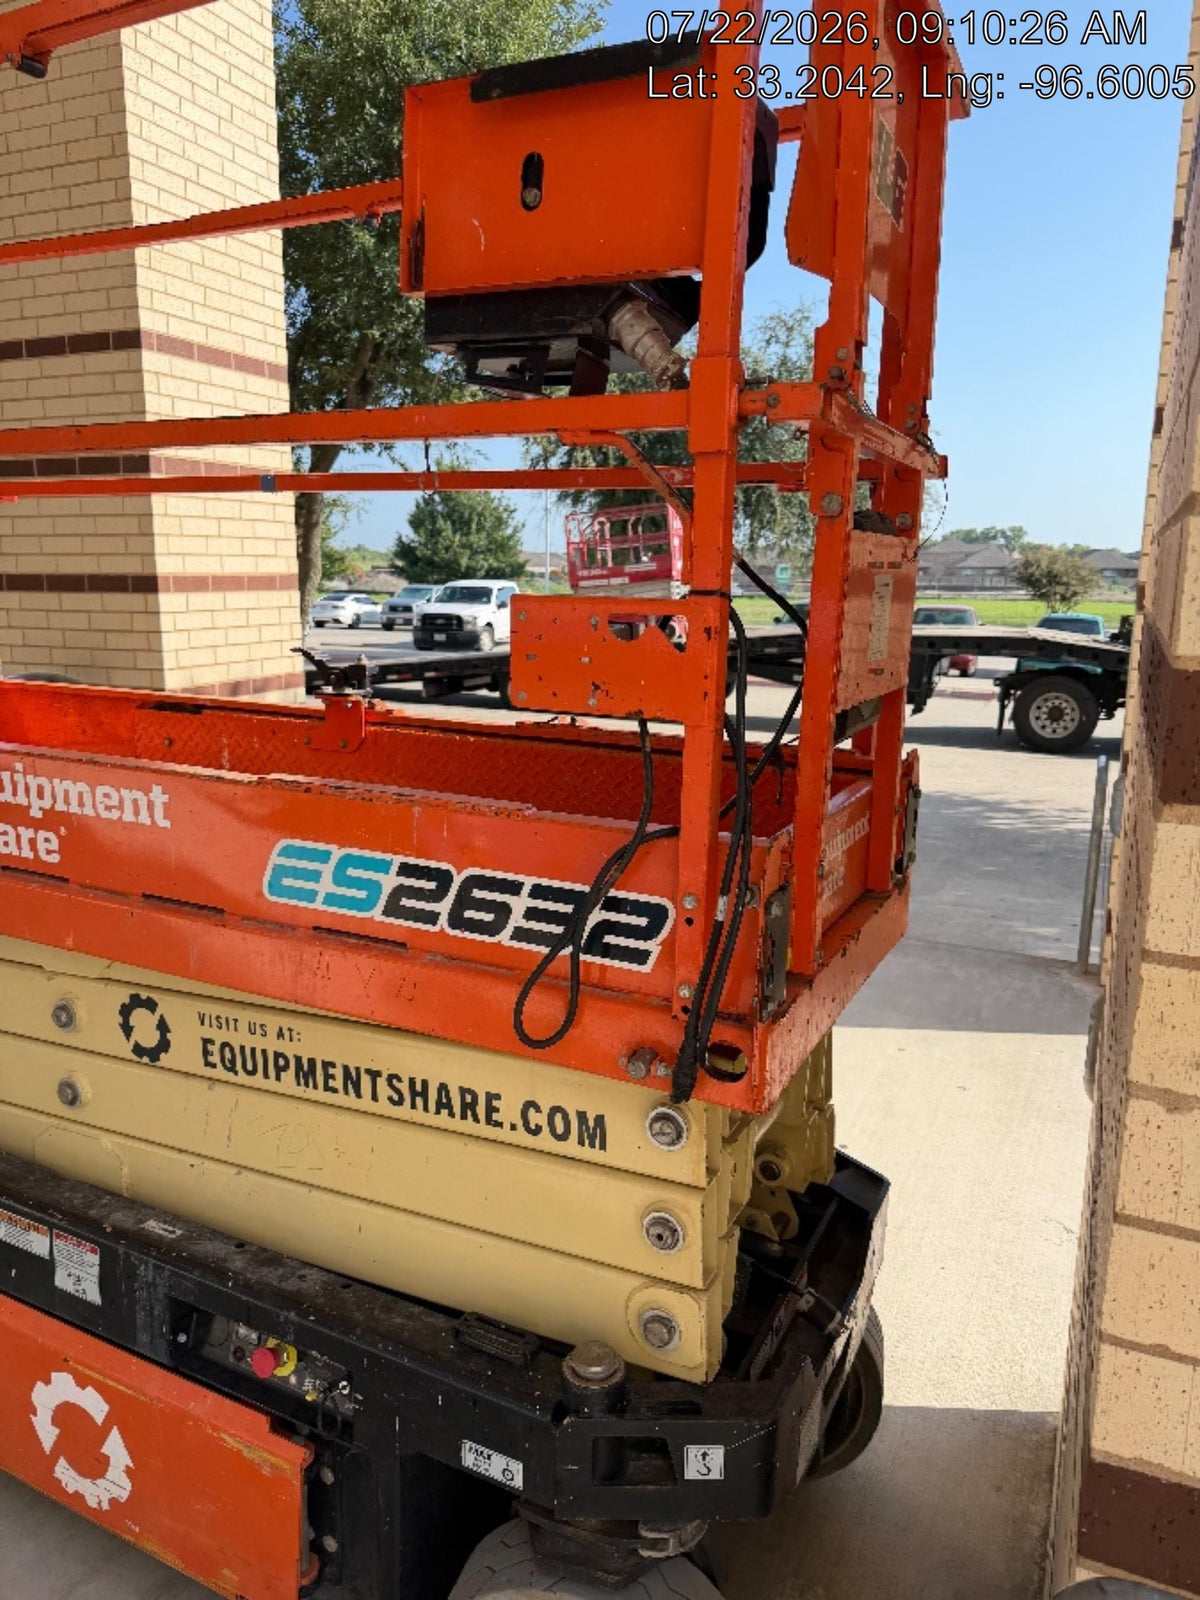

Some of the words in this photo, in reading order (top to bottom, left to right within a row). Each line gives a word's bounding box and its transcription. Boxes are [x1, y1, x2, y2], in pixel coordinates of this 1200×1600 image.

[263, 839, 675, 973] ES2632
[198, 1011, 239, 1032] VISIT
[248, 1021, 268, 1038] US
[276, 1025, 303, 1043] AT:
[200, 1037, 608, 1153] EQUIPMENTSHARE.COM
